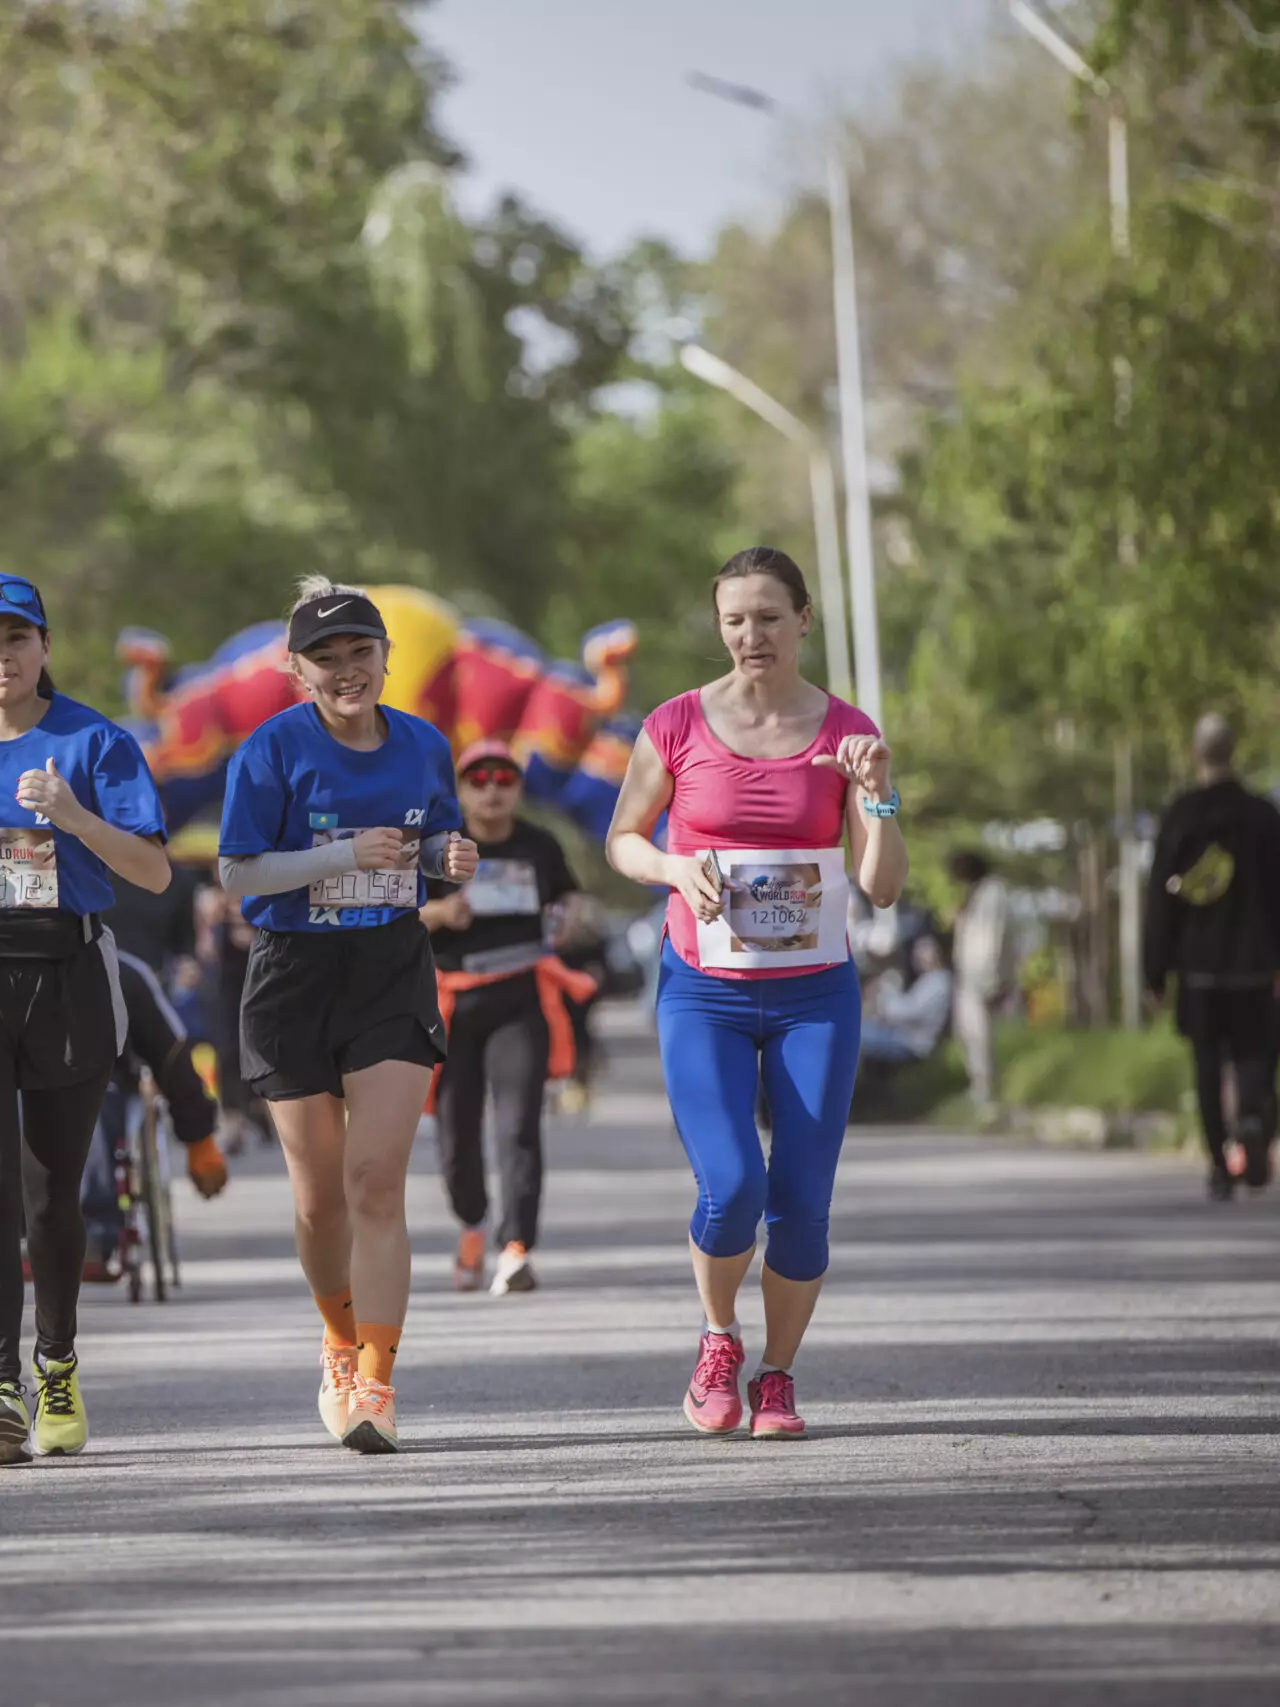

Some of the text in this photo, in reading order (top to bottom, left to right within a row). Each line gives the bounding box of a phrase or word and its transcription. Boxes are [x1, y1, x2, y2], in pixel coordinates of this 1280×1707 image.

[404, 808, 426, 825] 1X
[12, 847, 34, 859] RUN
[760, 890, 790, 901] WORLD
[751, 909, 804, 924] 121062
